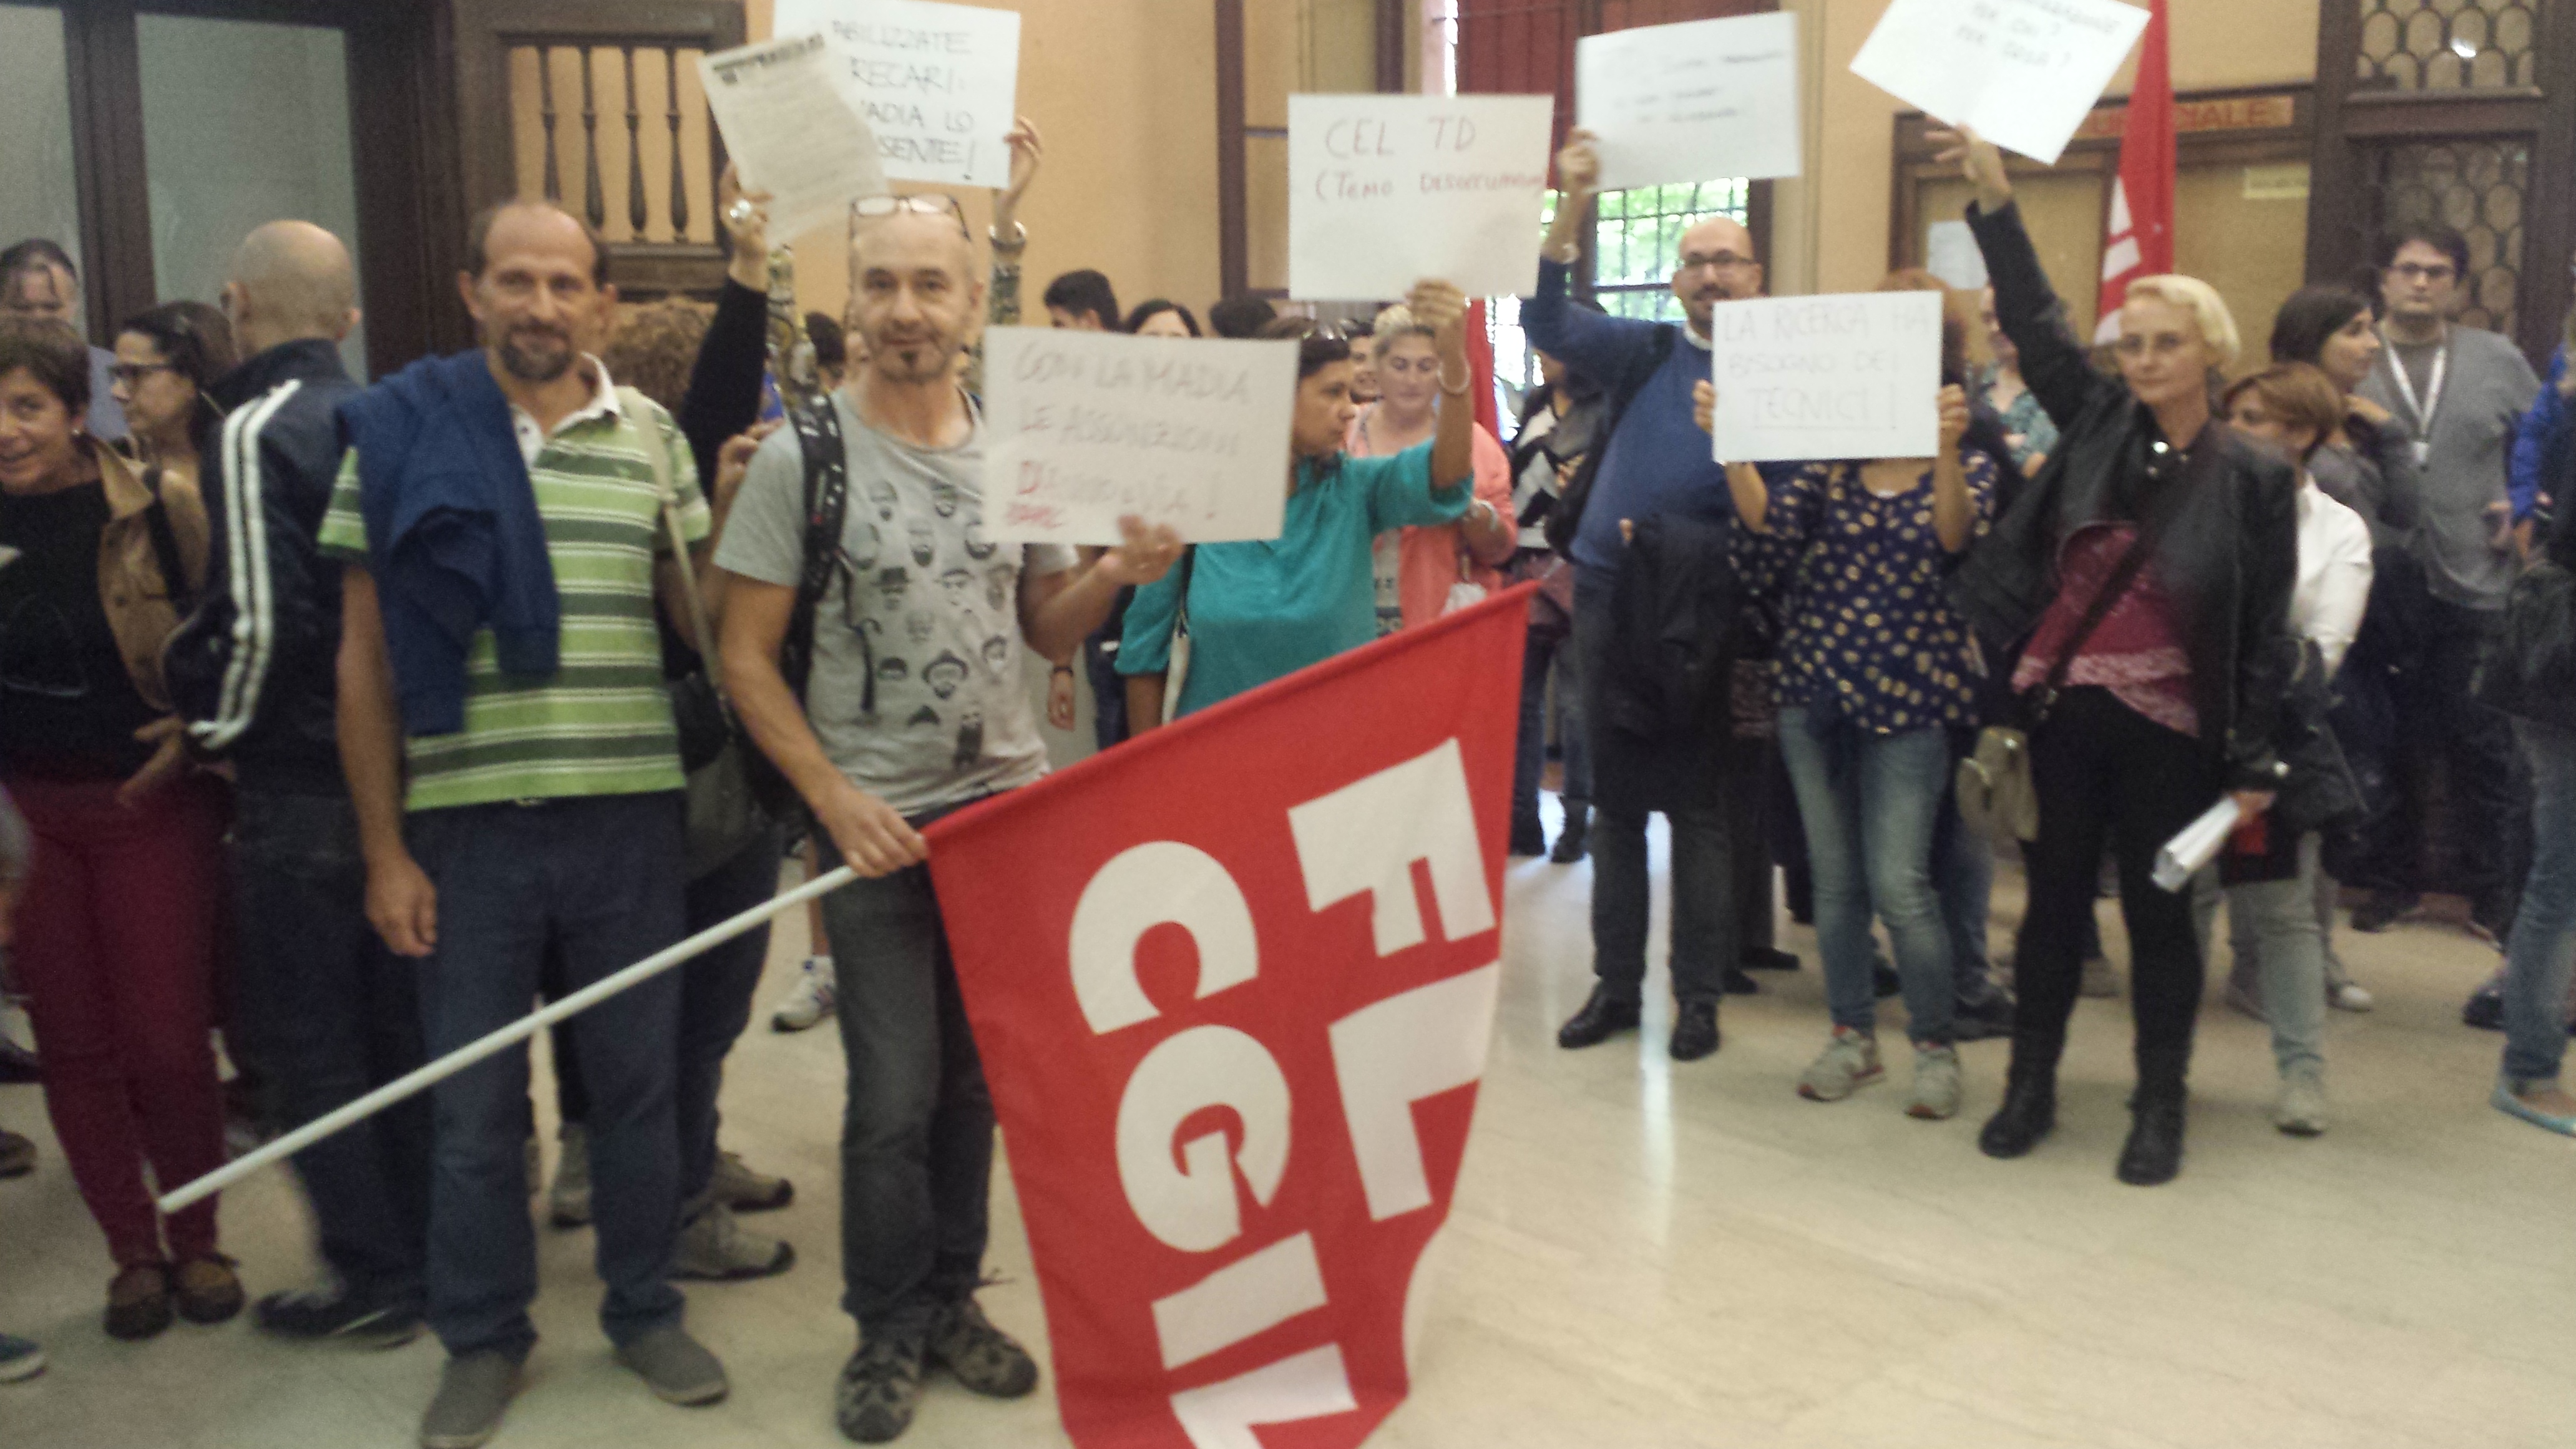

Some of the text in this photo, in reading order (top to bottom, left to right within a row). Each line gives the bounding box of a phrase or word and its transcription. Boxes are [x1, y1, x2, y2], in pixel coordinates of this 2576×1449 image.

[861, 99, 975, 133] ADIA LO
[1325, 114, 1477, 160] CEL TD
[1725, 308, 1757, 342] LA
[1095, 357, 1133, 388] LA
[1141, 358, 1251, 405] MADIA
